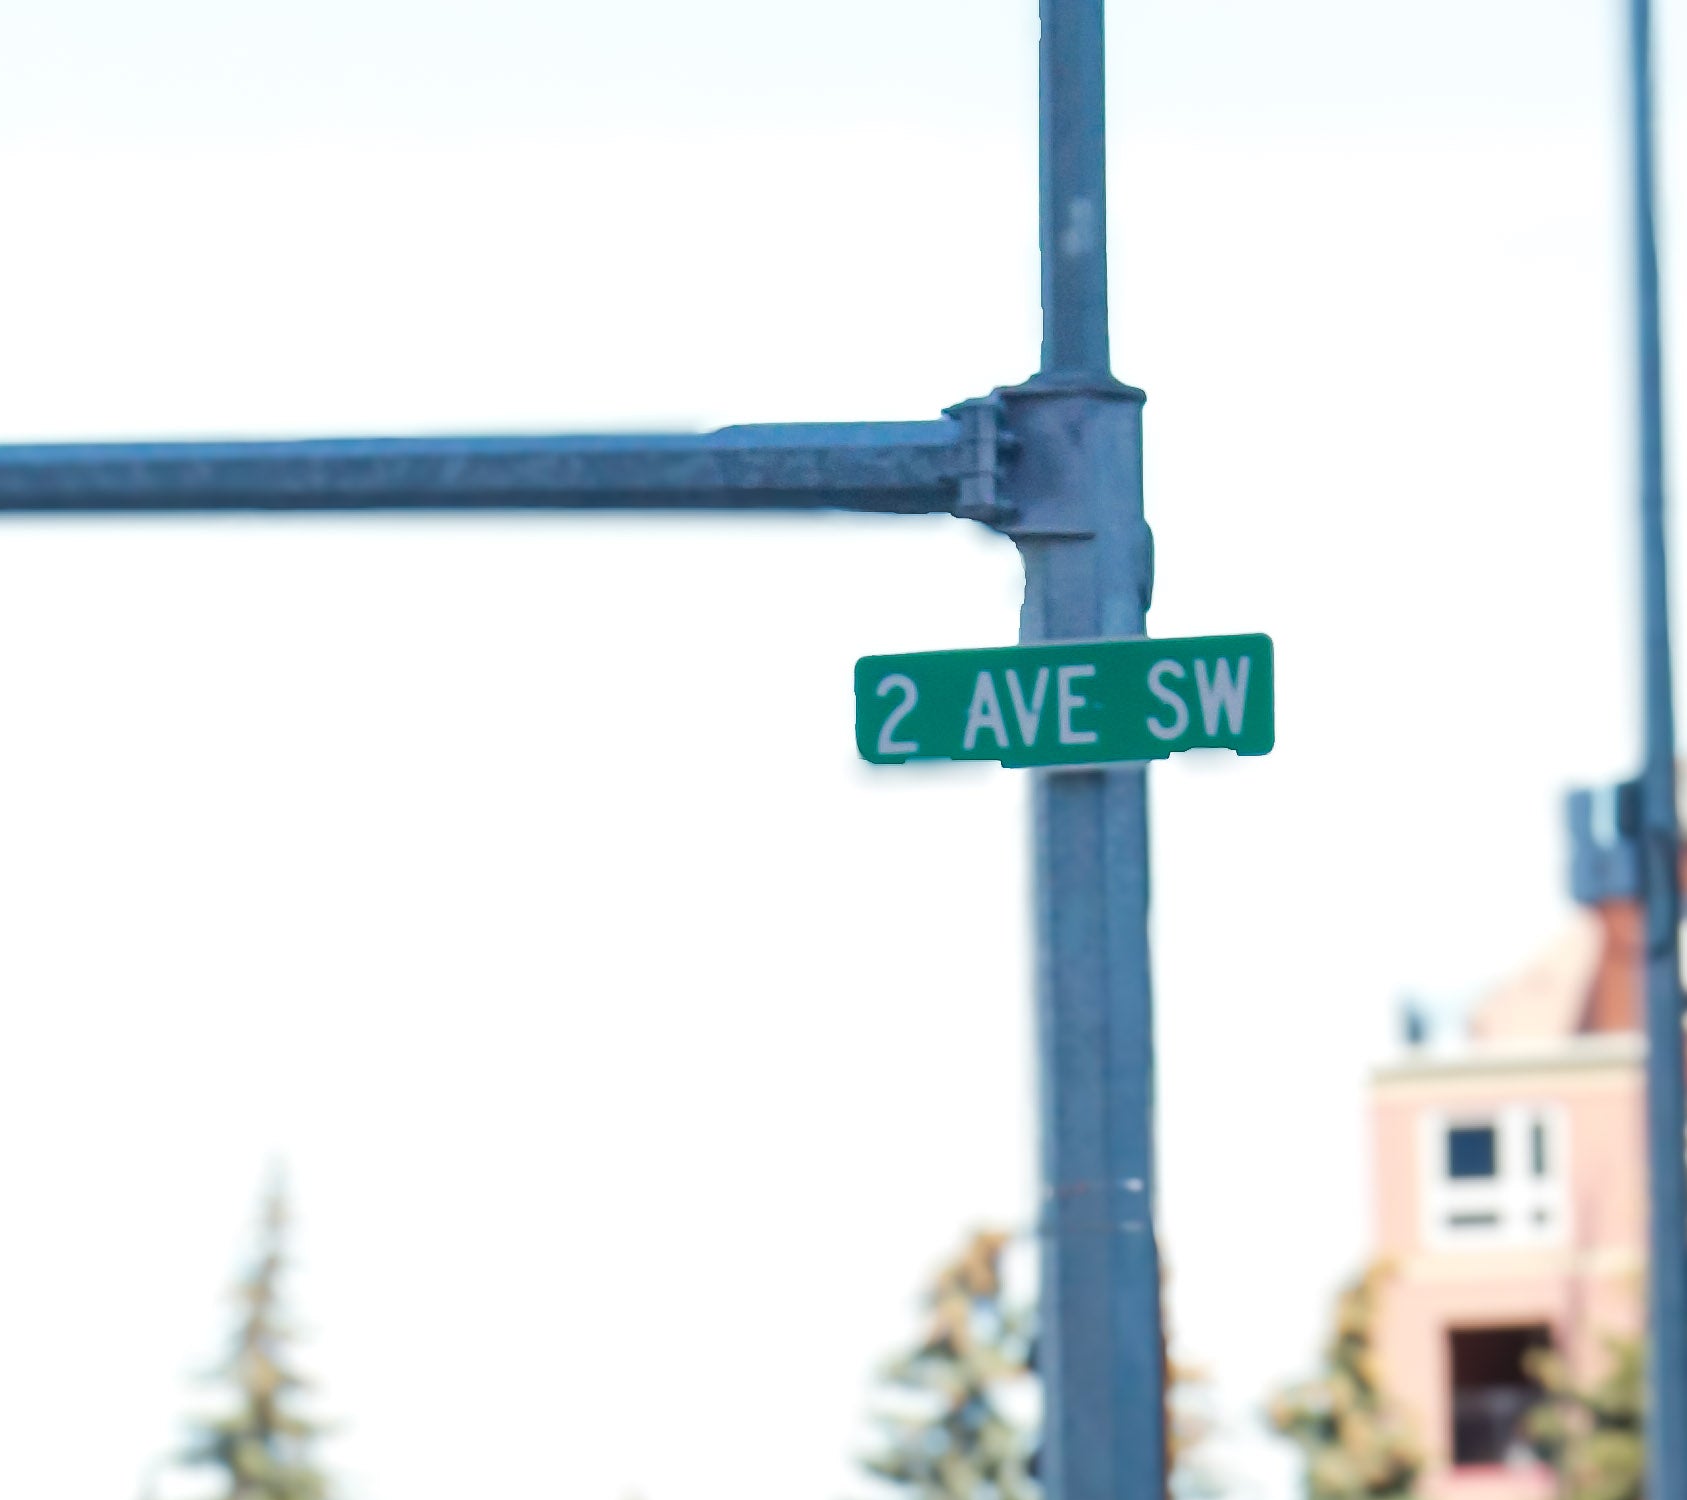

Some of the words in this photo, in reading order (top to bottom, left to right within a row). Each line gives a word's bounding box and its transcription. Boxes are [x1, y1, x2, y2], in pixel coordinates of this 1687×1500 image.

[875, 673, 919, 755] 2
[963, 664, 1098, 750] AVE
[1146, 655, 1251, 741] SW
